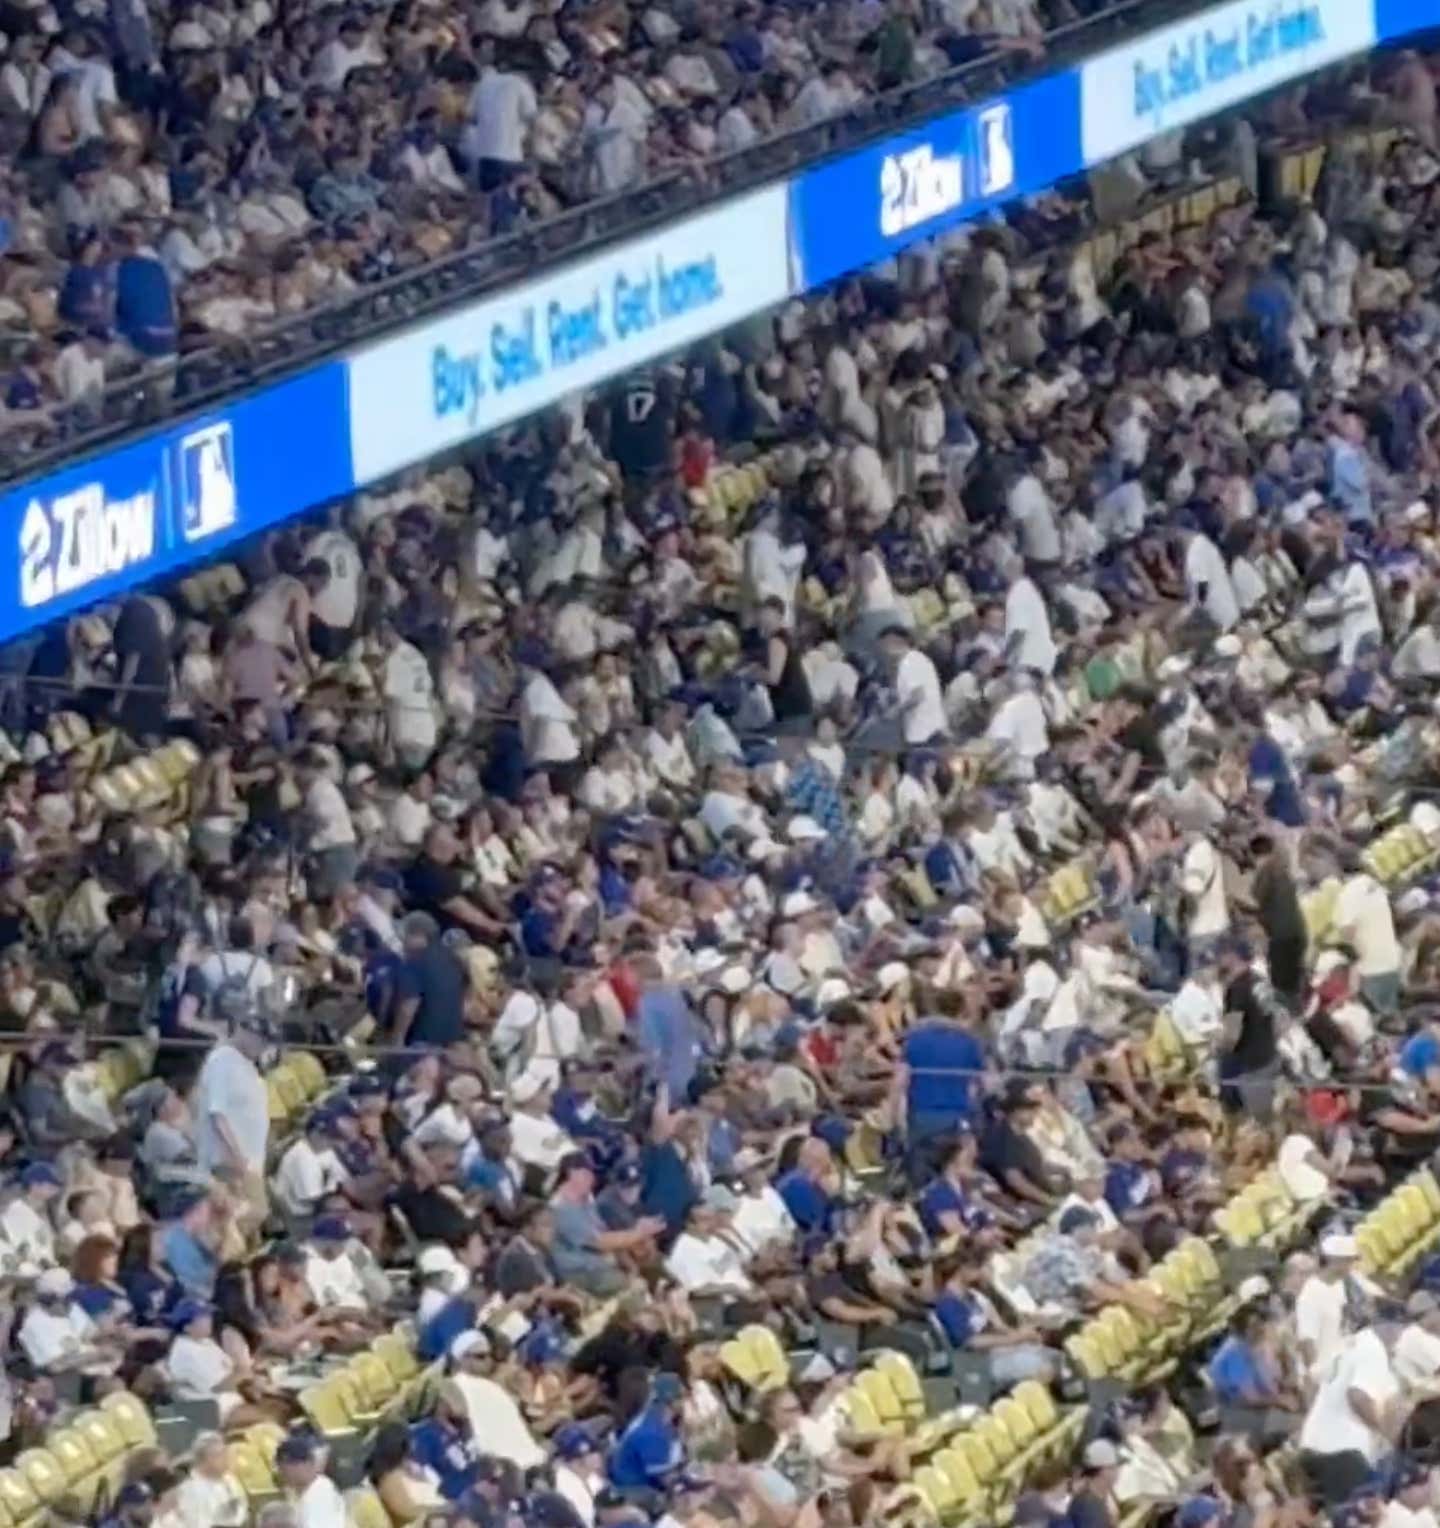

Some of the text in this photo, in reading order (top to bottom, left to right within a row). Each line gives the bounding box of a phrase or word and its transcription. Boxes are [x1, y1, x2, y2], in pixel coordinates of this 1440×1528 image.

[432, 252, 724, 427] Buy. Sell. Rent. Get home.
[52, 481, 154, 597] Zillow
